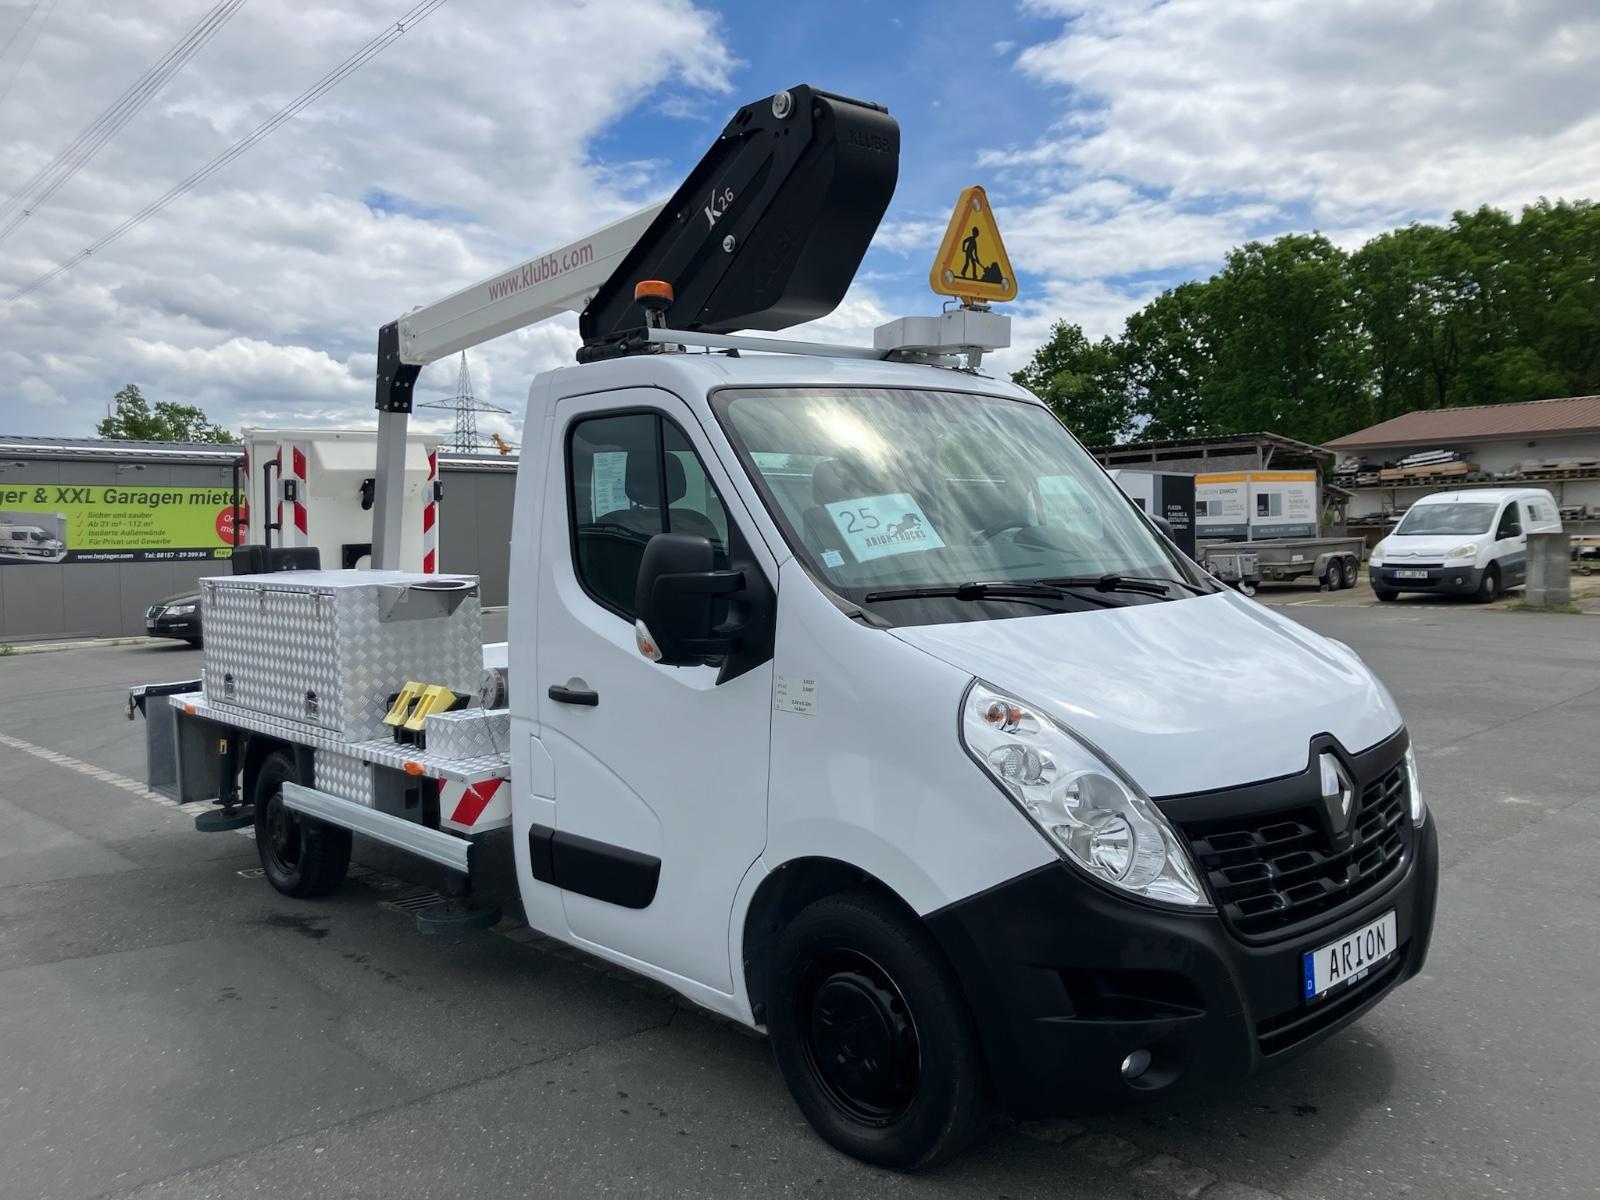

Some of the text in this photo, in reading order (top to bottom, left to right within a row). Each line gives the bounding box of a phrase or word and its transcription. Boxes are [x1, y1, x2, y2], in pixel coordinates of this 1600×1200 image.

[488, 243, 593, 301] www.klubb.com
[33, 487, 48, 504] &
[54, 488, 97, 504] XXL
[103, 488, 184, 508] Garagen
[87, 511, 153, 519] Sicher und sauber
[839, 508, 880, 534] 25
[1329, 922, 1386, 982] ARION
[1307, 979, 1313, 990] D
